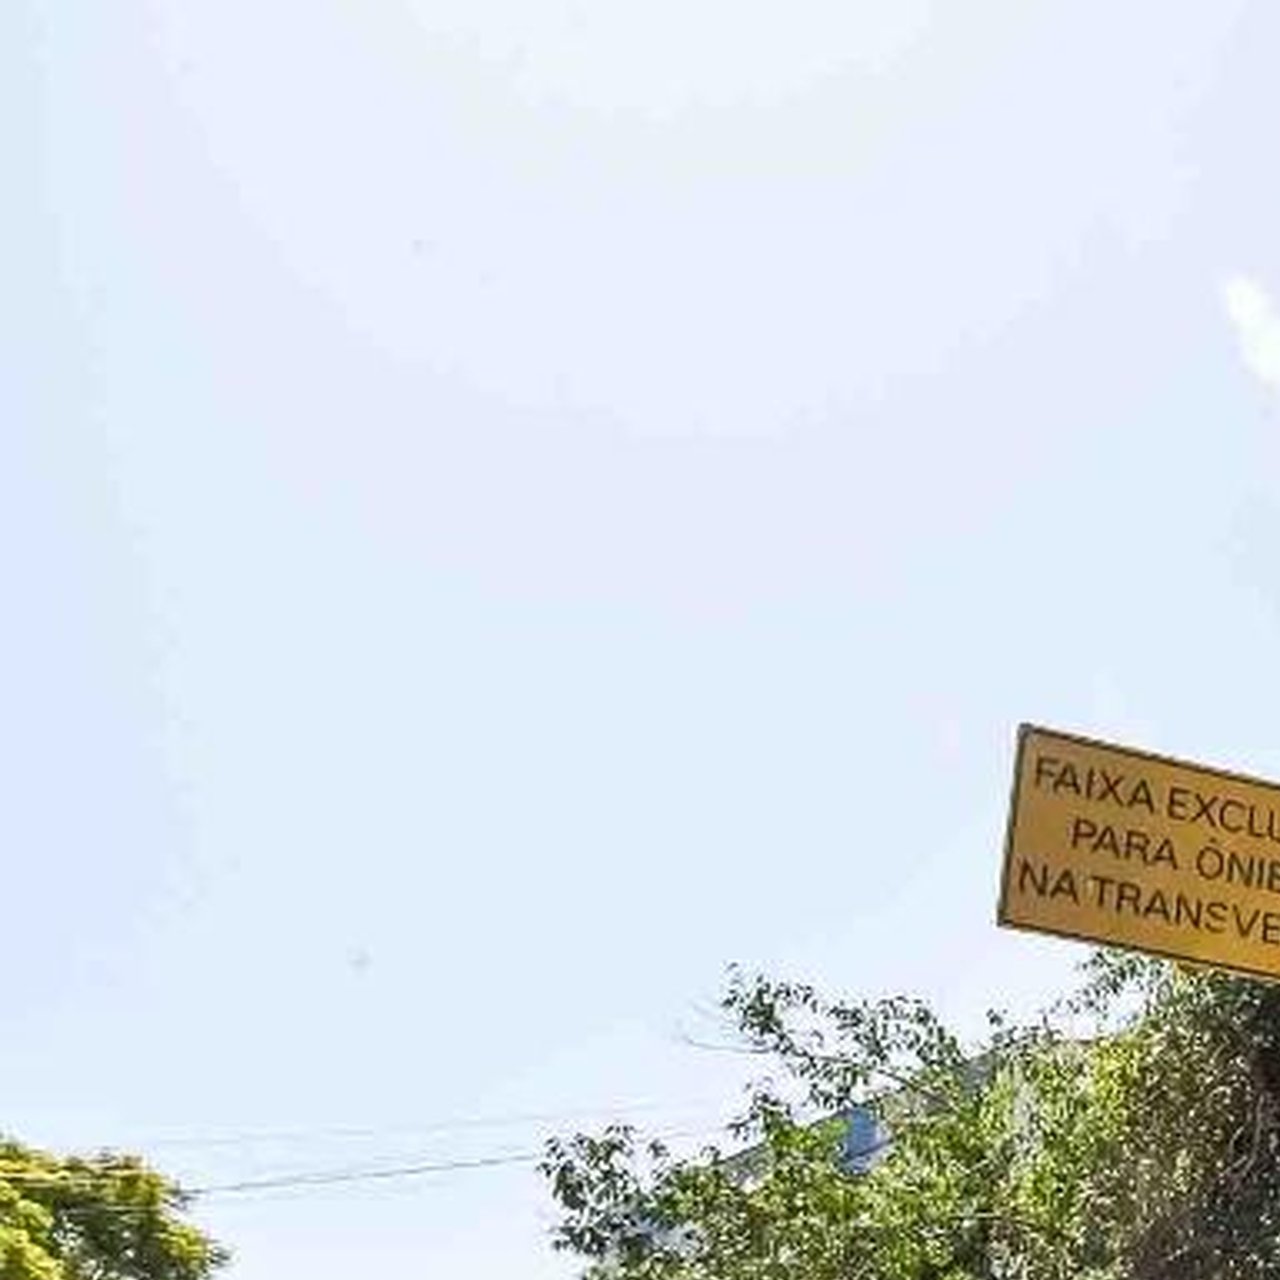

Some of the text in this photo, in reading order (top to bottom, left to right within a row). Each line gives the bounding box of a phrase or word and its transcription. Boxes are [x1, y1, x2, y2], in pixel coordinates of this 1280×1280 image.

[1034, 755, 1154, 814] FAIXA
[1070, 817, 1178, 870] PARA
[1018, 857, 1079, 905] NA
